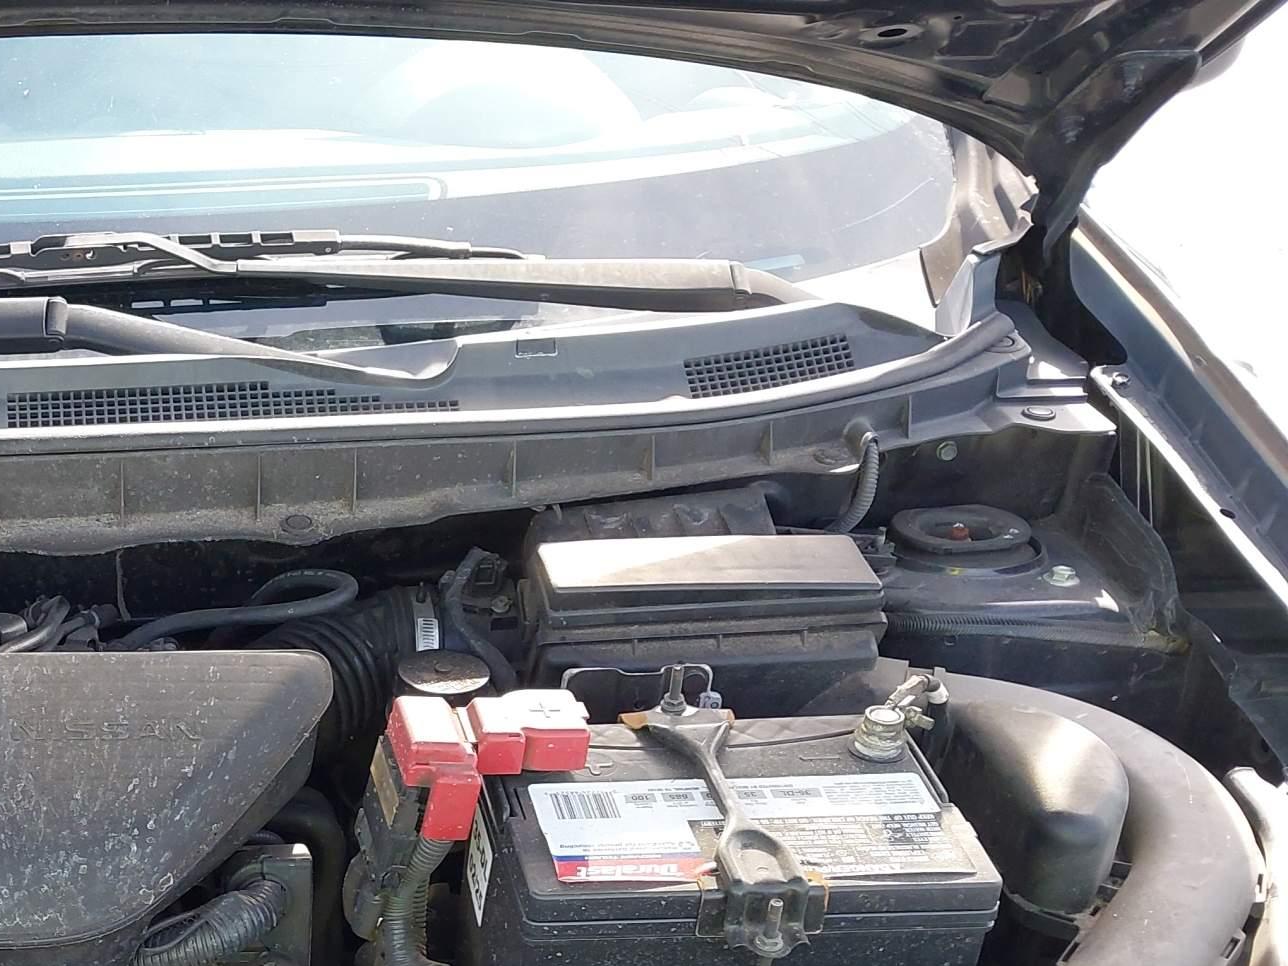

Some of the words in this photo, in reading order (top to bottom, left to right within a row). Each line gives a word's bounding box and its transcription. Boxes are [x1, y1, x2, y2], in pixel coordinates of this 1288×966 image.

[11, 719, 202, 742] NISSAN
[631, 794, 650, 802] 100
[576, 863, 682, 879] Duralast
